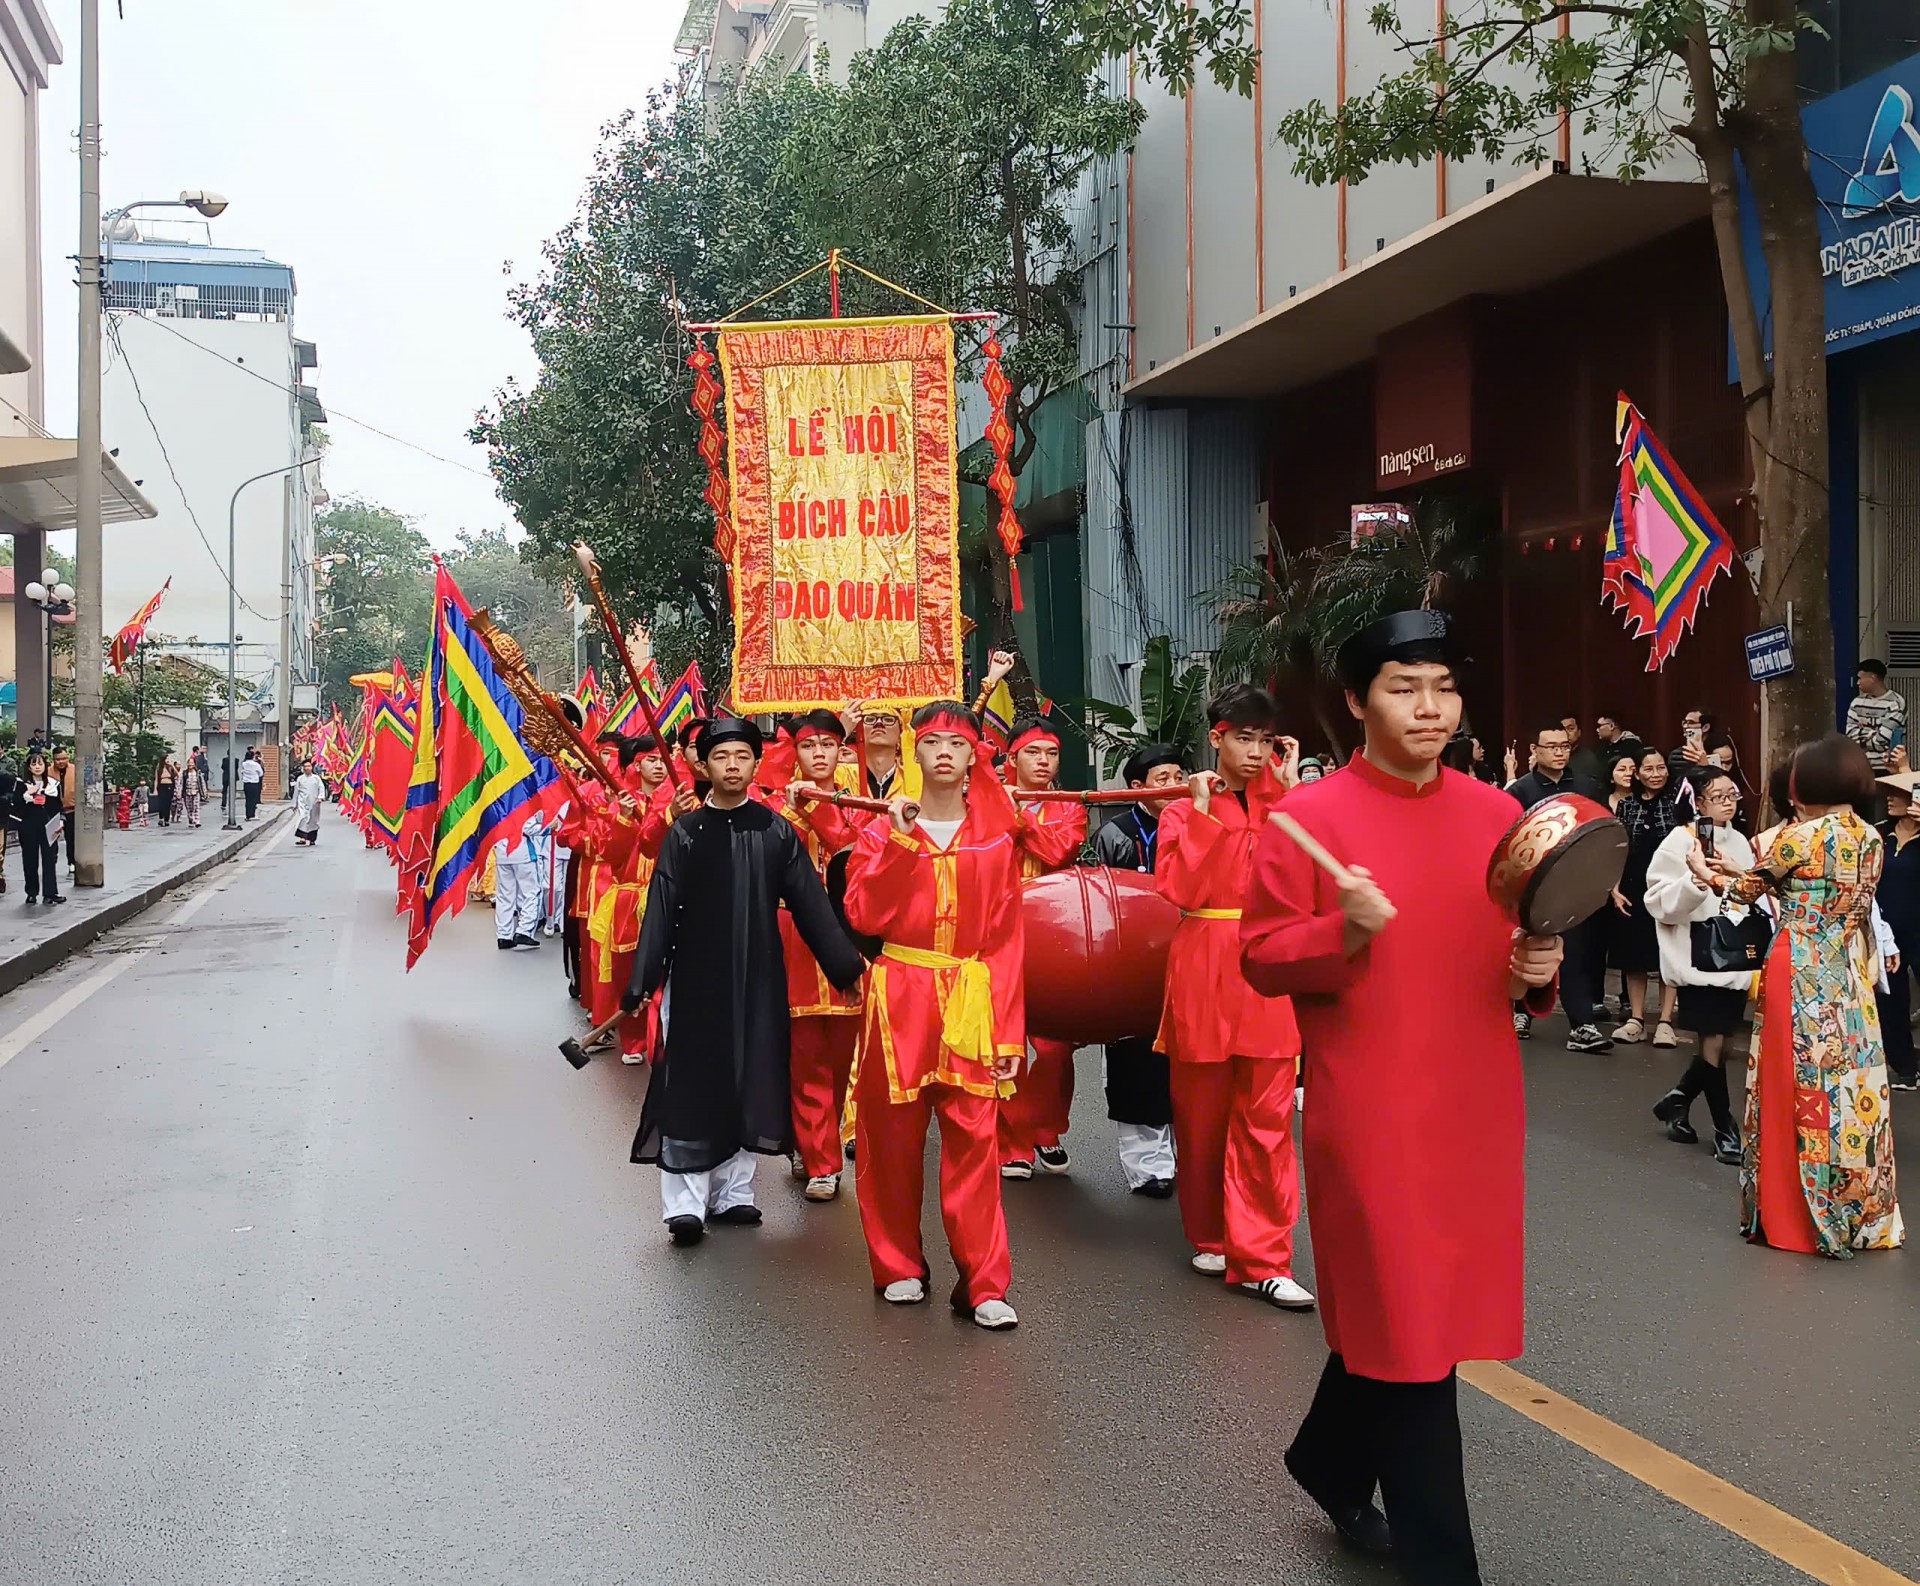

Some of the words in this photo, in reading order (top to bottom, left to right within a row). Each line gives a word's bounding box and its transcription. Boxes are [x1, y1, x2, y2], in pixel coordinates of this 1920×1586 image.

[788, 406, 832, 457] LỄ
[845, 405, 897, 461] HỘI
[778, 492, 847, 540] BÍCH
[858, 488, 911, 537] CÂU
[774, 580, 831, 627] ĐẠO
[837, 573, 916, 622] QUÁN
